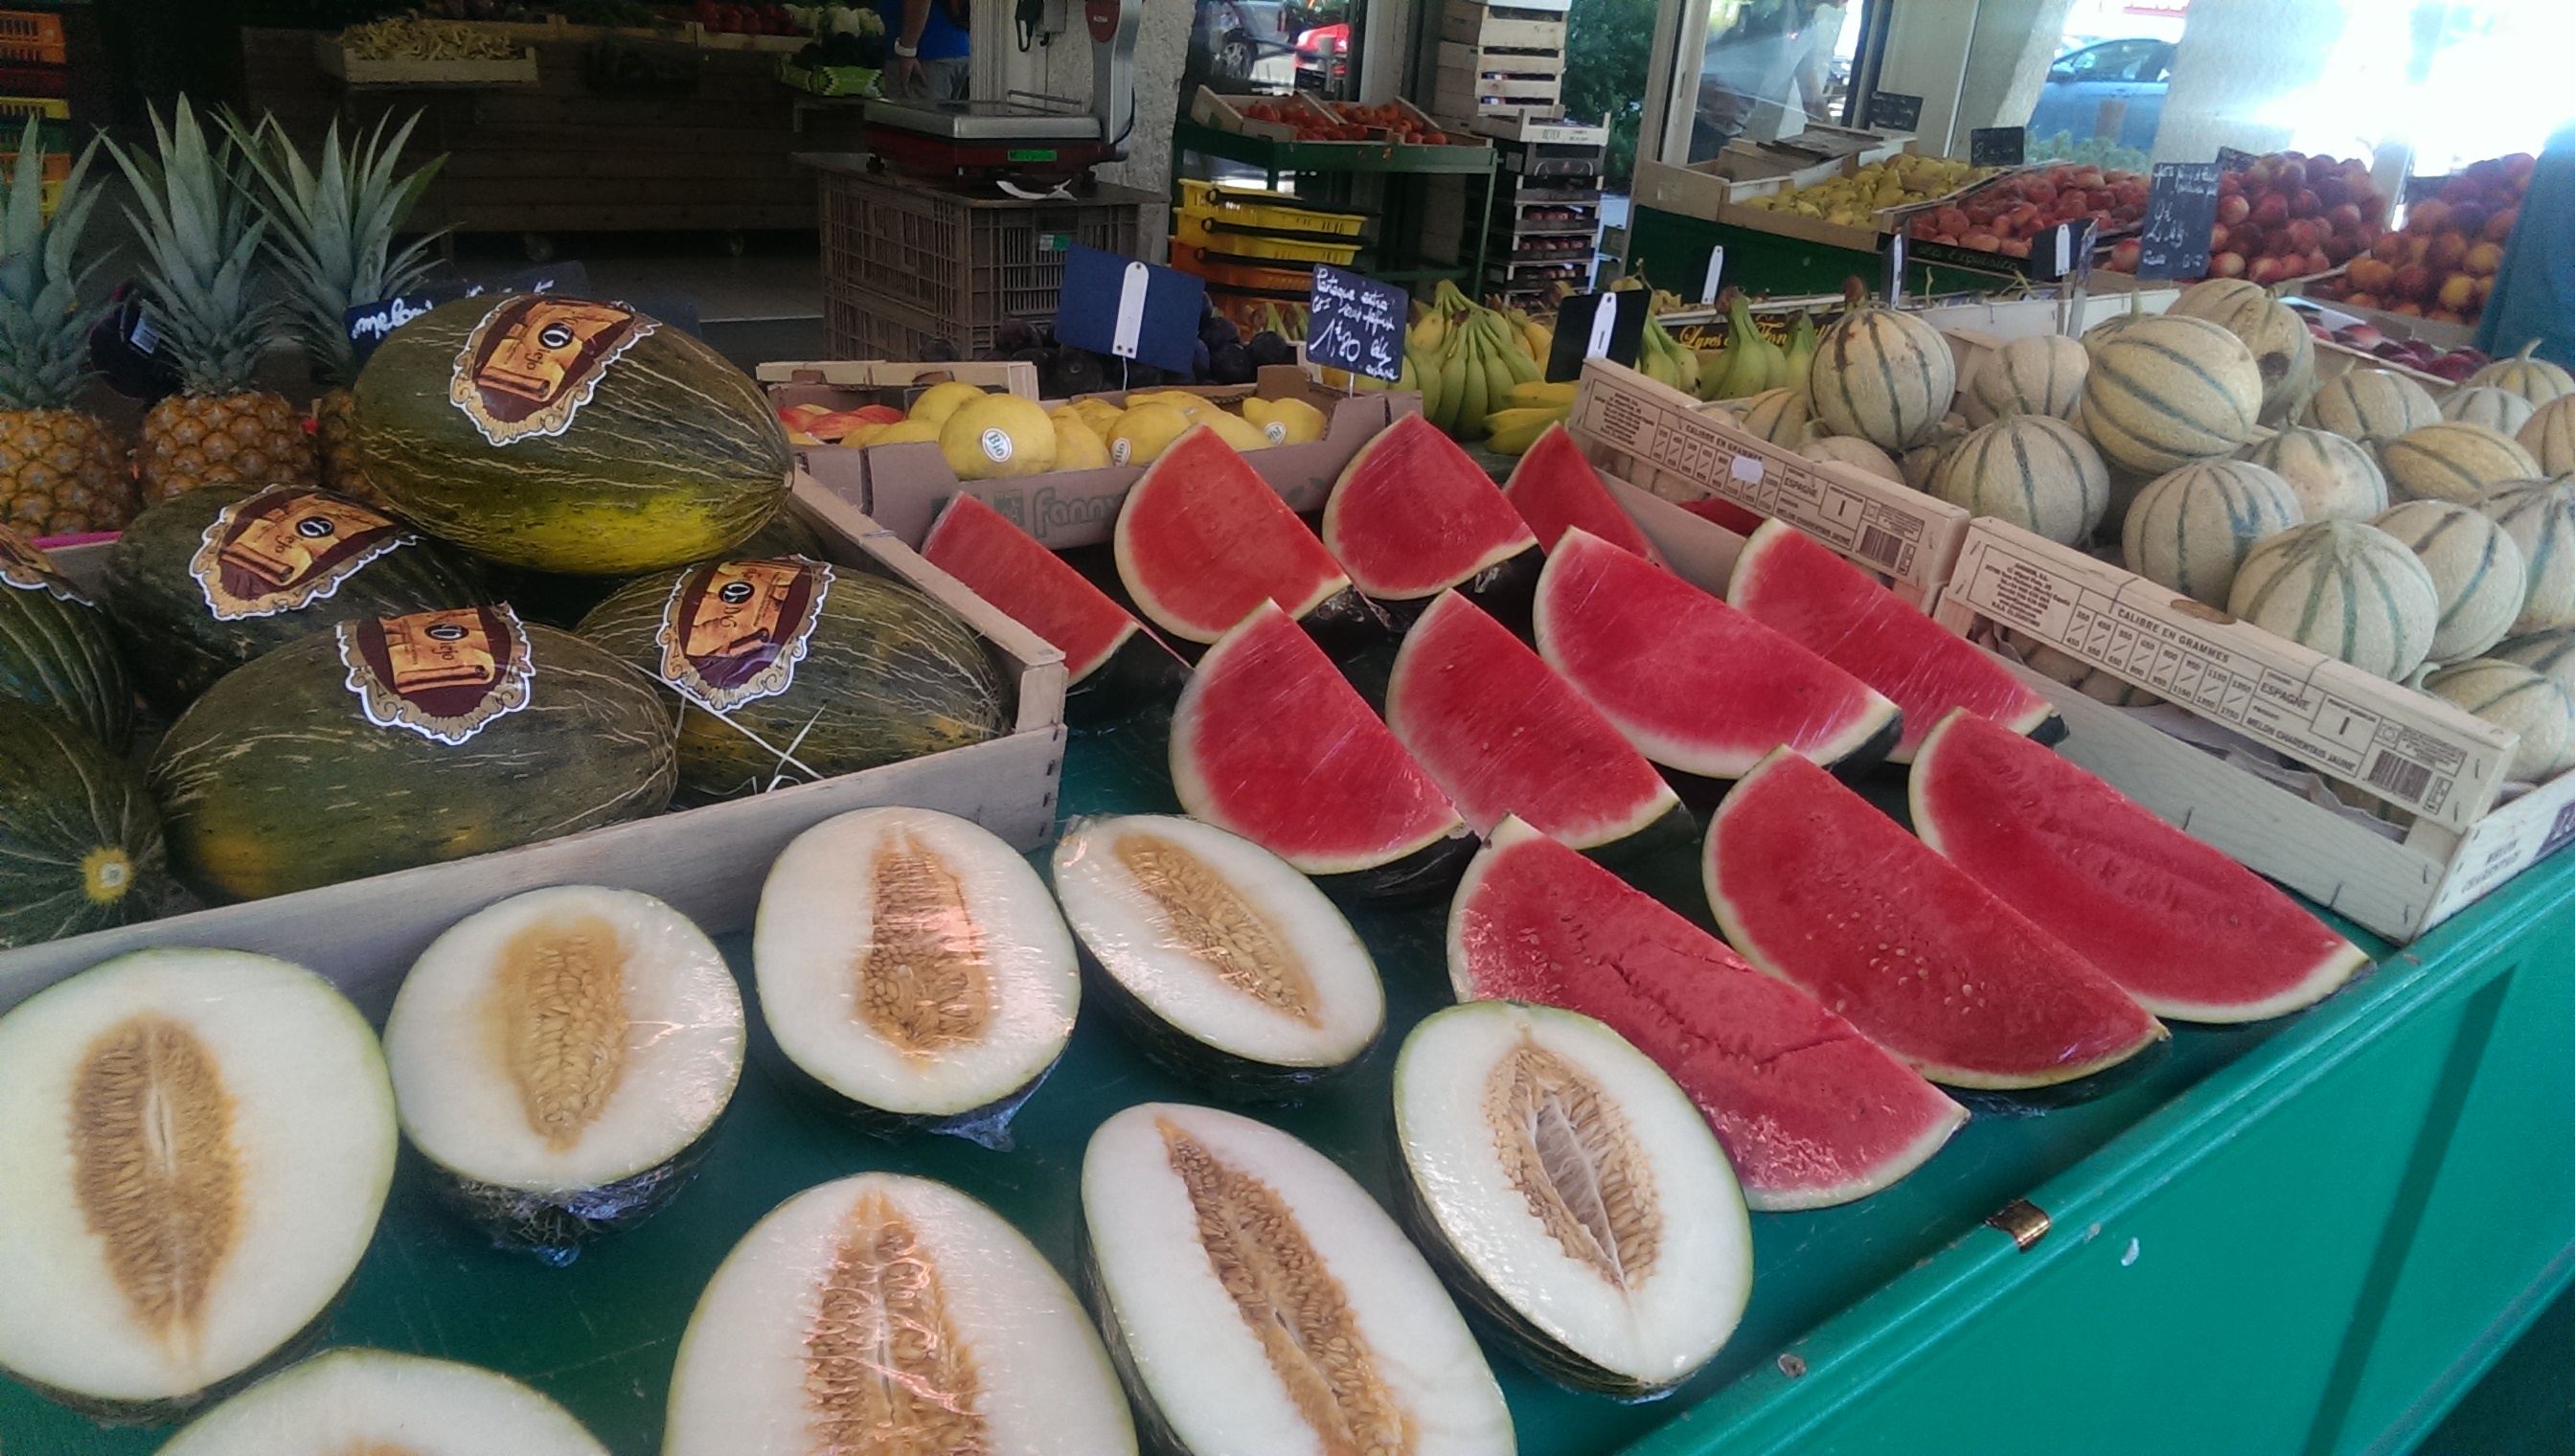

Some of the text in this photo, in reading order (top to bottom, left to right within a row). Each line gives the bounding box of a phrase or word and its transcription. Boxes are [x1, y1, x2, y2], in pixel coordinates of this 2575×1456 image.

[988, 433, 1005, 457] Bio
[2117, 608, 2232, 664] CALIBRE EN GRAMMES
[2261, 681, 2311, 712] ESPAGNE
[2245, 717, 2358, 771] MELON CHARENTAIS JAUNE
